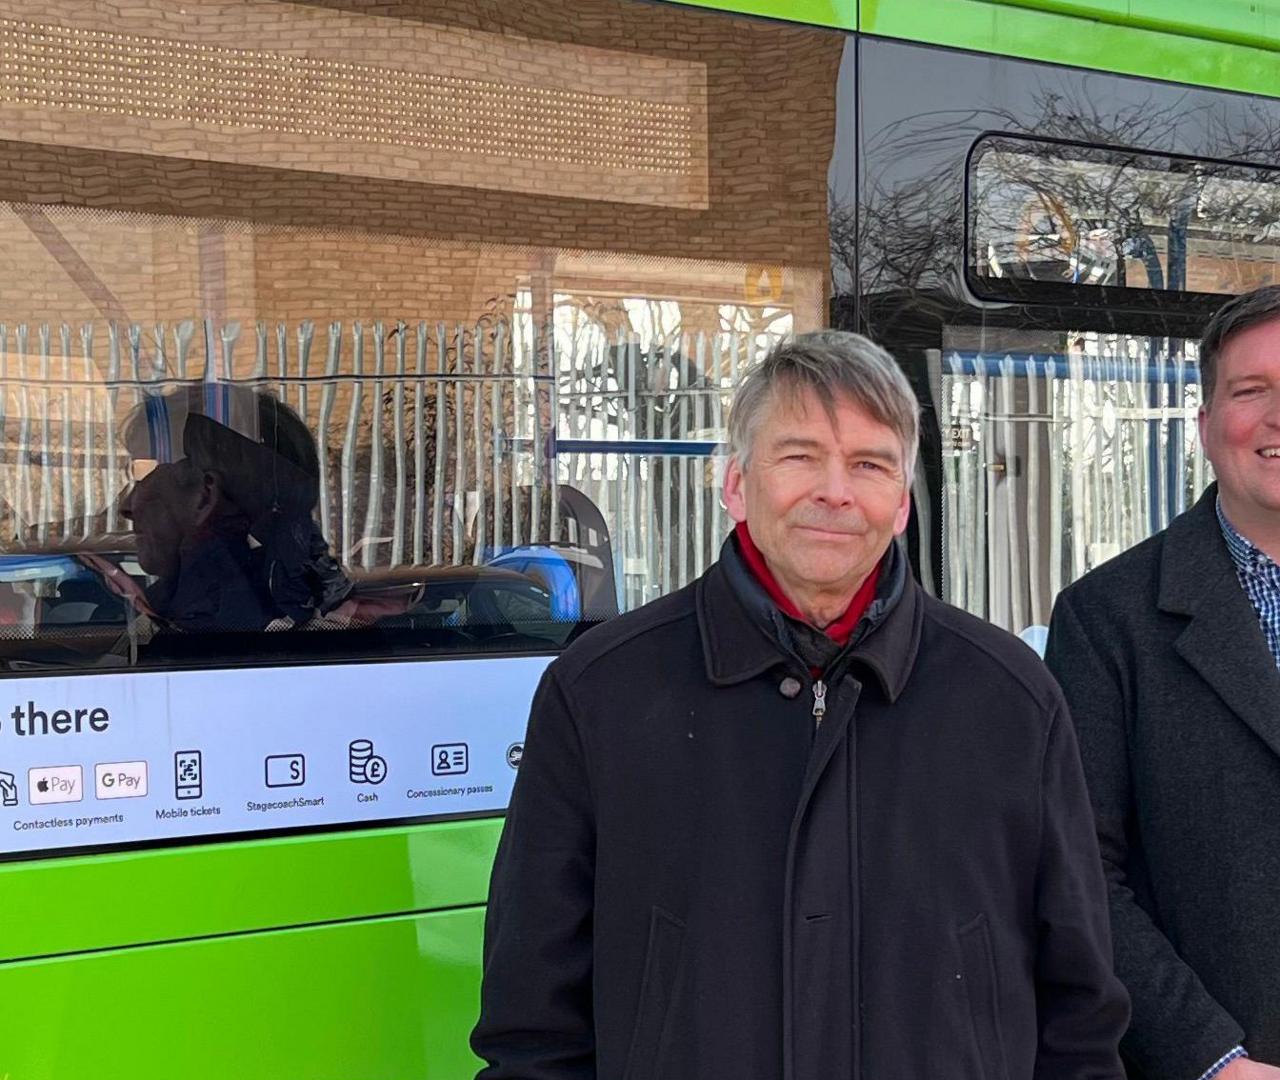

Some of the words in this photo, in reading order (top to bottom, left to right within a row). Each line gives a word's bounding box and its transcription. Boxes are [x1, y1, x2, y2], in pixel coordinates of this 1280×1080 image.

[11, 701, 109, 736] there
[51, 775, 75, 794] Pay
[118, 771, 141, 790] Pay
[357, 791, 378, 803] Cash
[406, 786, 466, 799] Concessionary
[467, 785, 493, 798] passes
[246, 796, 325, 812] StagecoachSmart
[155, 807, 188, 820] Mobile
[190, 806, 221, 817] tickets
[13, 817, 73, 832] Contactless
[75, 813, 124, 829] payments
